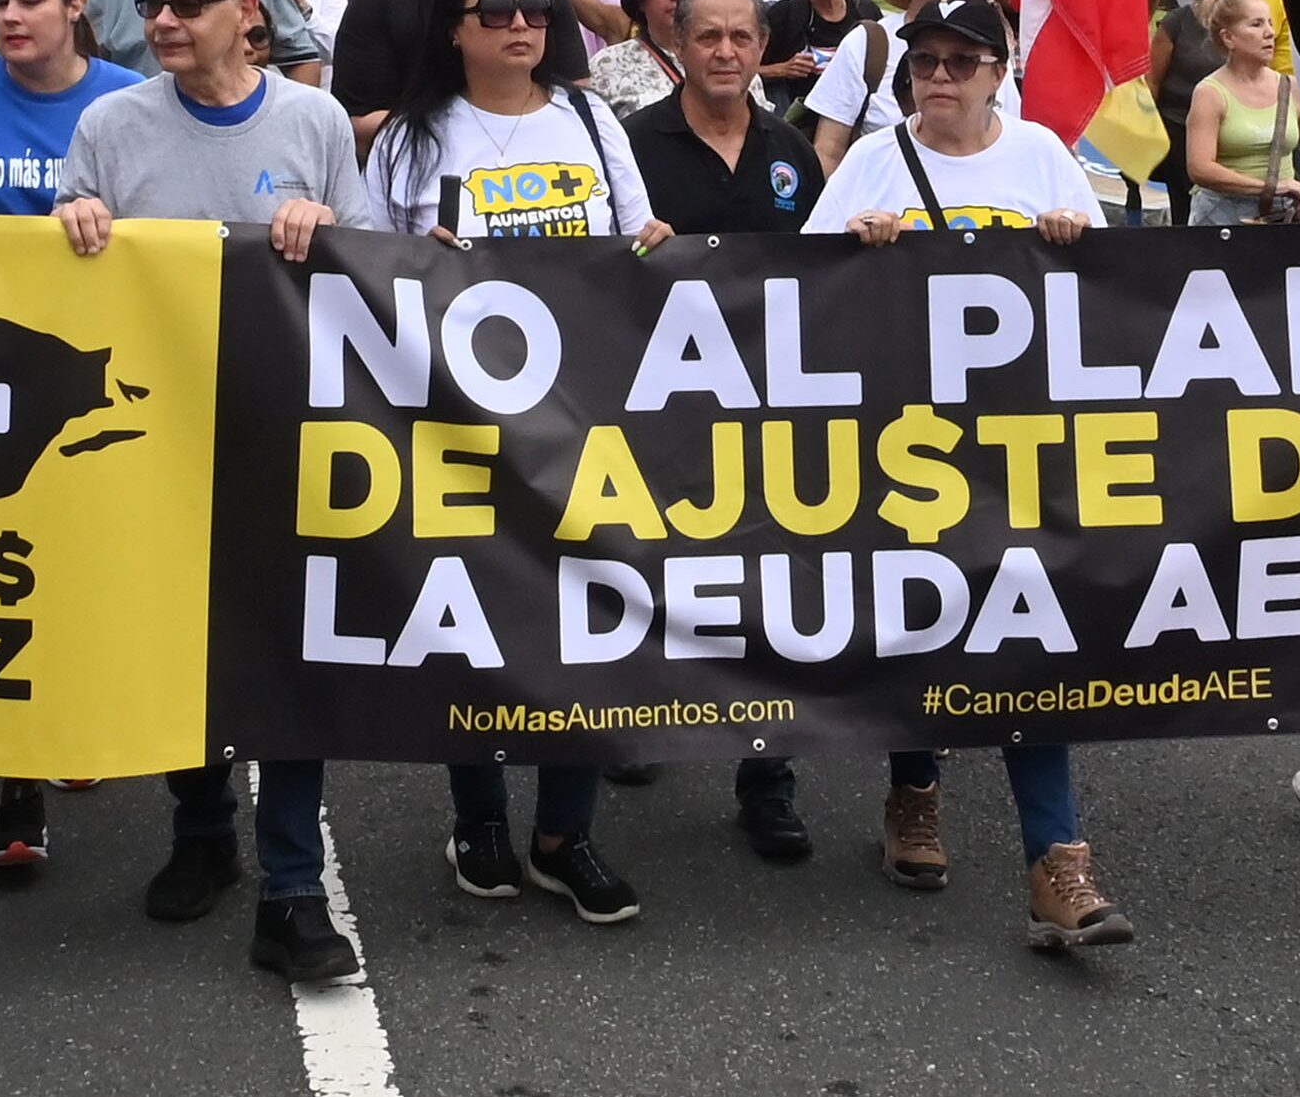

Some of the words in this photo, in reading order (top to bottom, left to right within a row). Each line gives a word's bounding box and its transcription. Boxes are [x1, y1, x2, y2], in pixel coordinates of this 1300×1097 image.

[9, 147, 41, 189] más
[545, 219, 588, 237] LUZ
[308, 272, 563, 415] NO
[624, 276, 863, 412] AL
[295, 420, 501, 539] DE
[552, 403, 1164, 544] AJU$TE
[302, 554, 506, 670] LA
[558, 546, 1080, 666] DEUDA
[448, 695, 796, 733] NoMasAumentos.com
[921, 666, 1274, 716] #CancelaDeudaAEE
